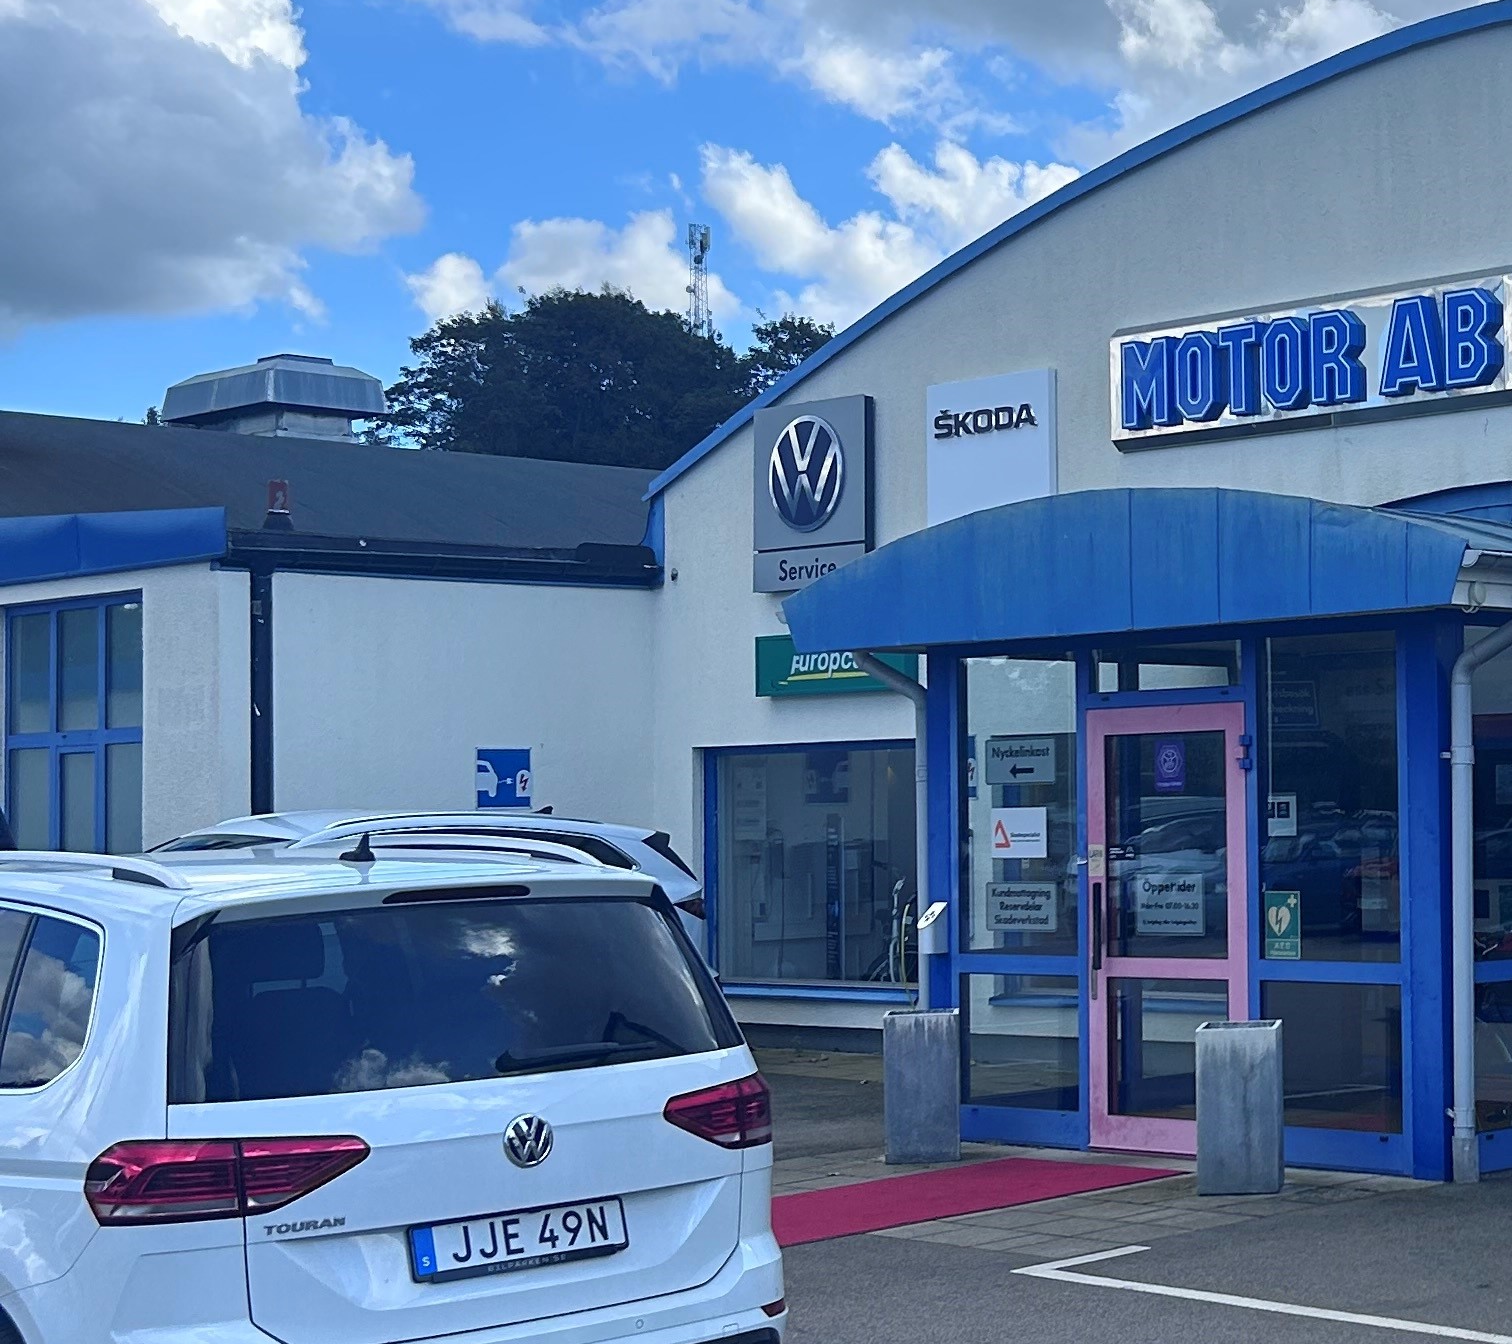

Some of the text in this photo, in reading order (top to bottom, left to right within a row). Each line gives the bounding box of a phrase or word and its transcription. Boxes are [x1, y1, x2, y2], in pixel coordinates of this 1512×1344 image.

[1121, 309, 1367, 430] MOTOR
[1379, 288, 1504, 397] AB
[934, 403, 1038, 439] ŠKODA
[263, 1216, 346, 1236] TOURAN
[452, 1206, 609, 1263] JJE 49N
[422, 1256, 430, 1268] S
